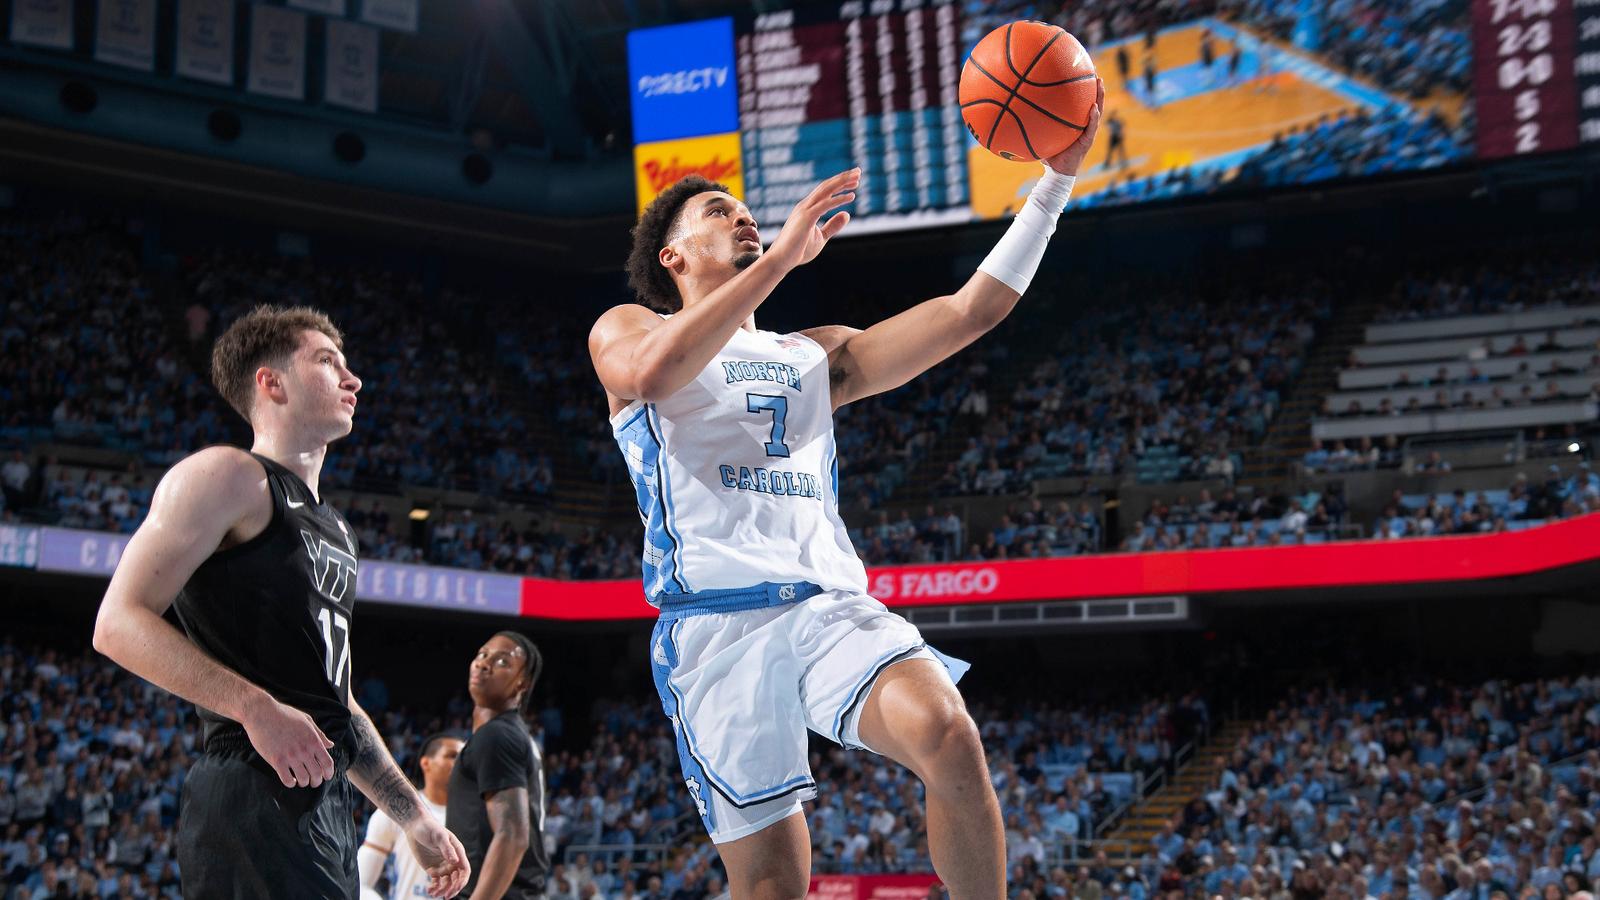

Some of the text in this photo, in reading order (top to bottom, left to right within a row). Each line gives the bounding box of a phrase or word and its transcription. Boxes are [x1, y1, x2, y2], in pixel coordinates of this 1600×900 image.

[638, 66, 728, 98] DIRECTV
[1515, 121, 1540, 153] 2
[722, 361, 802, 393] NORTH
[746, 392, 790, 459] 7
[300, 529, 357, 602] VT
[901, 568, 998, 598] FARGO
[318, 607, 349, 688] 17
